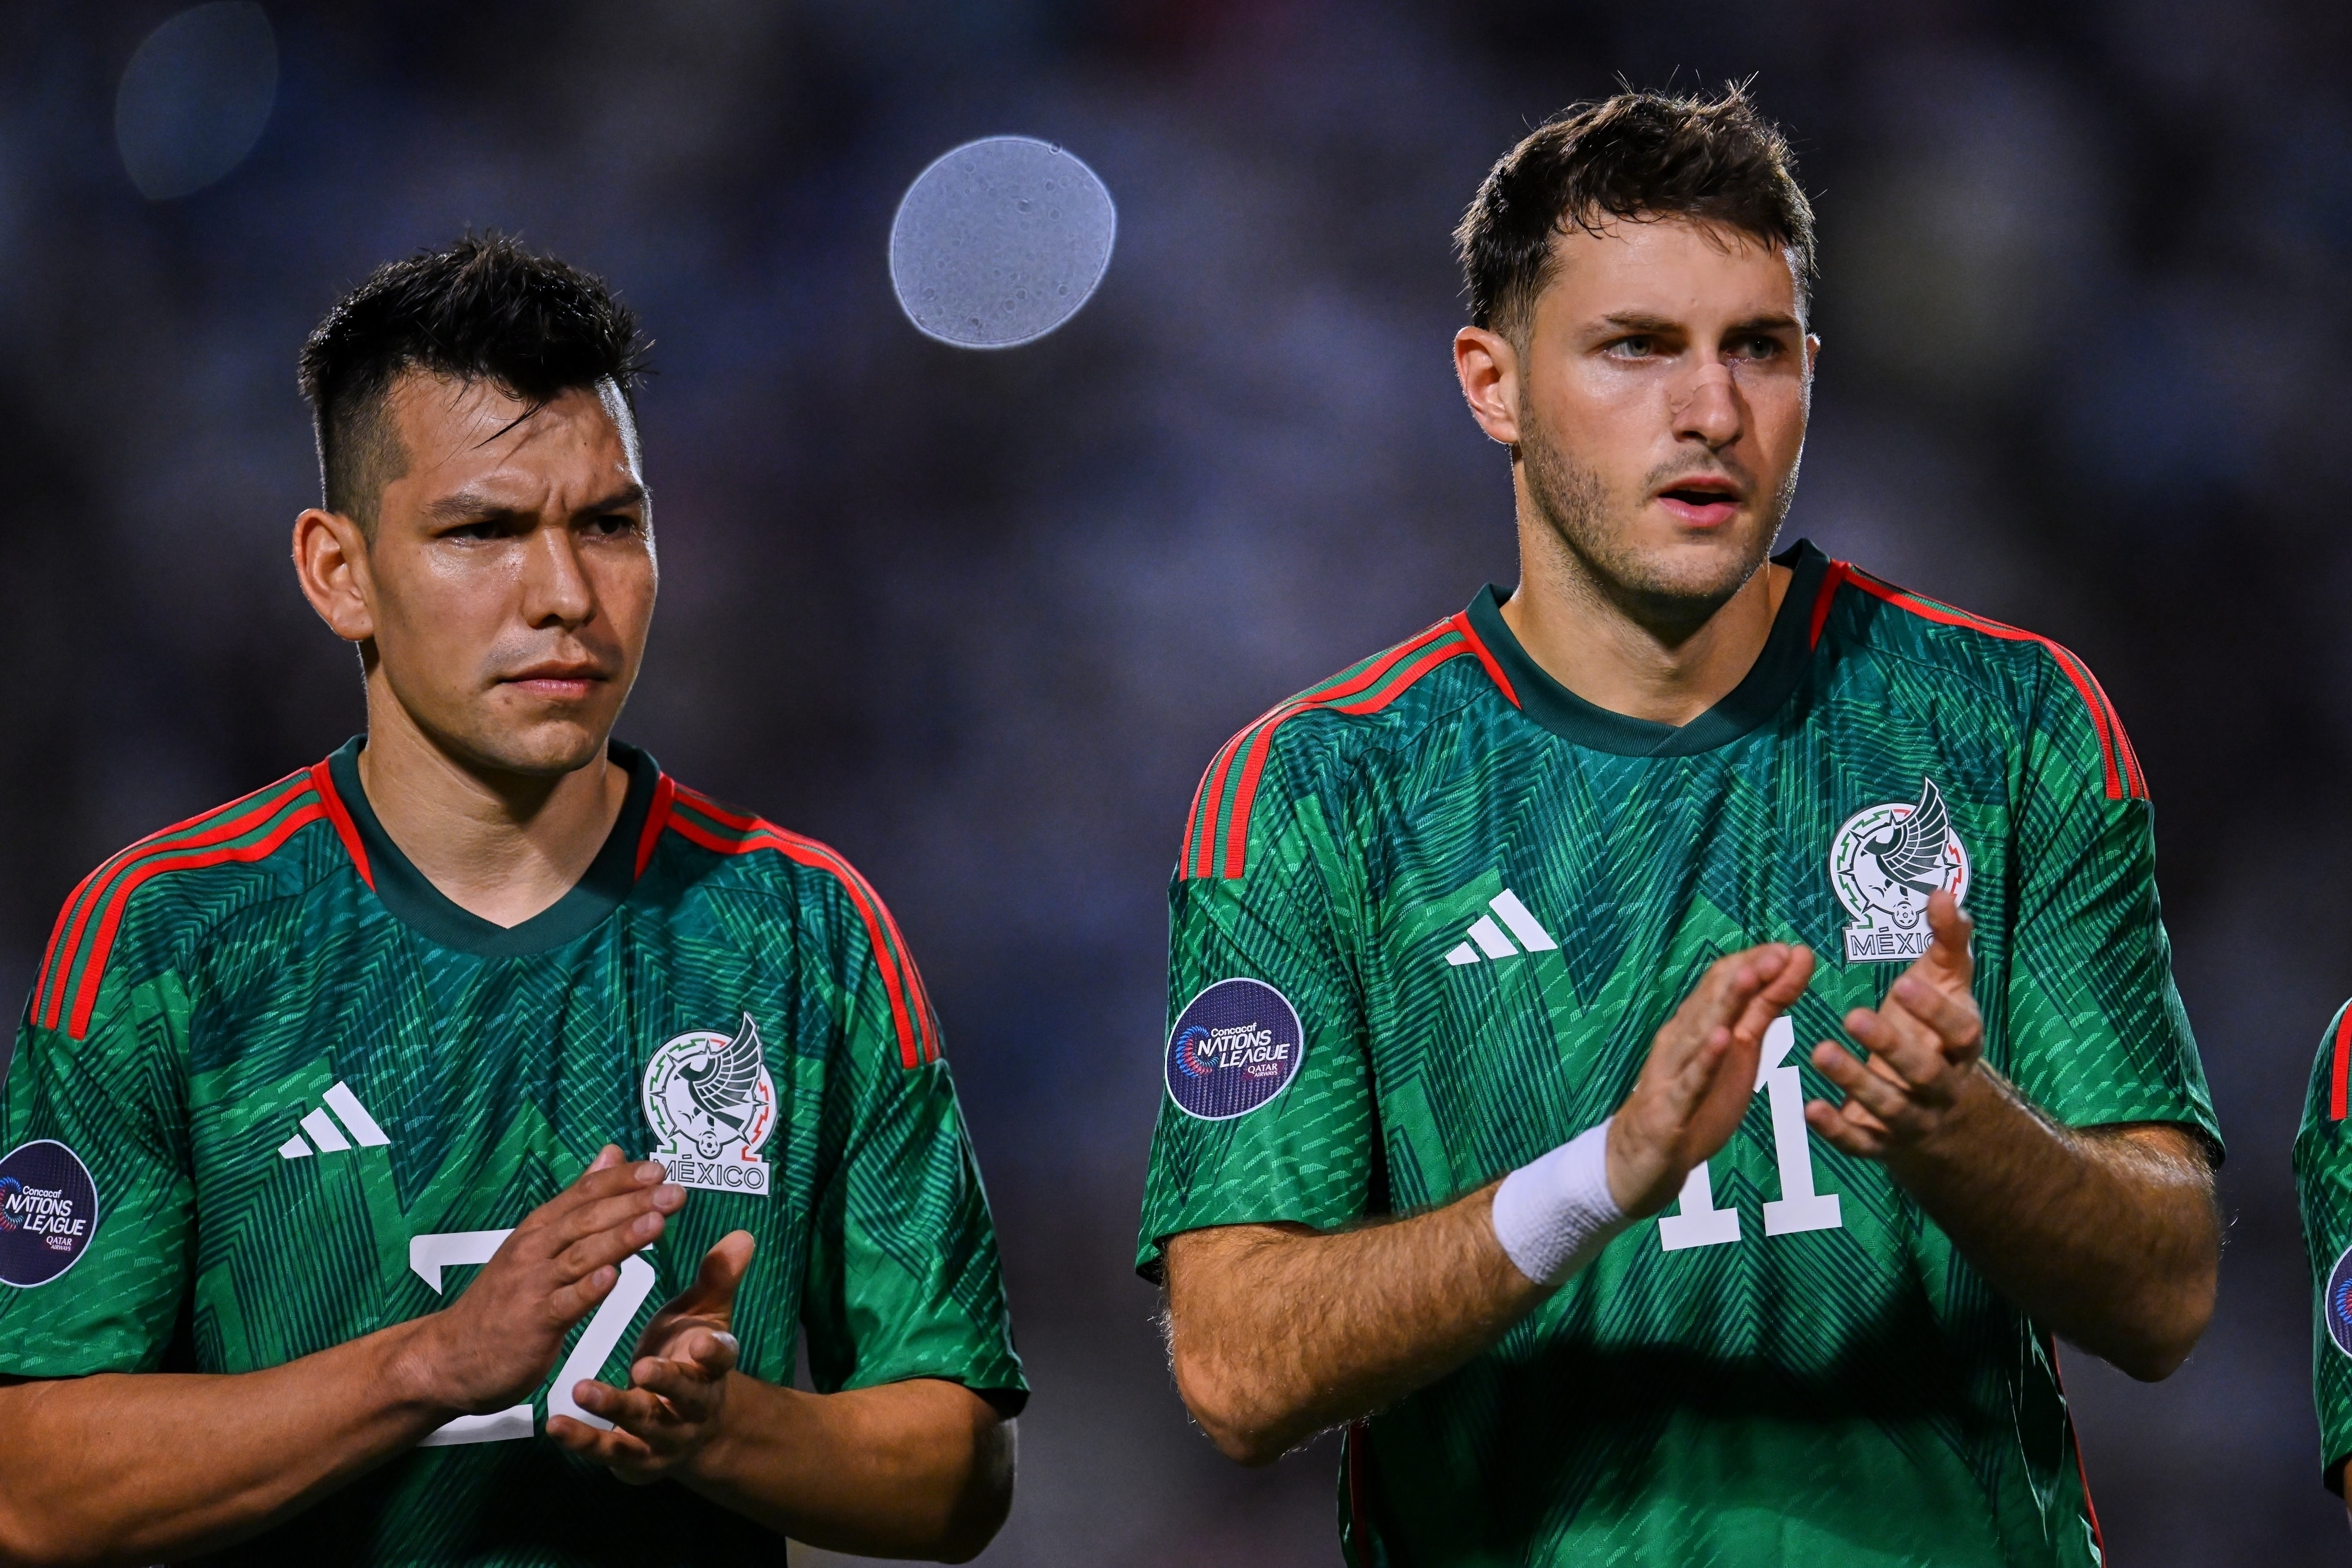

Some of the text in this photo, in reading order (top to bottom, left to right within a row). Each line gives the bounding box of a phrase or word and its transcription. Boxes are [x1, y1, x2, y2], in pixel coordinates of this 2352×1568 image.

[1211, 1022, 1257, 1037] Concacaf
[1197, 1029, 1272, 1057] NATIONS
[1220, 1043, 1291, 1068] LEAGUE
[1248, 1063, 1278, 1074] QATAR
[22, 1185, 62, 1198] Concacaf
[5, 1193, 73, 1216] NATIONS
[23, 1213, 86, 1236] LEAGUE
[46, 1236, 72, 1246] QATAR
